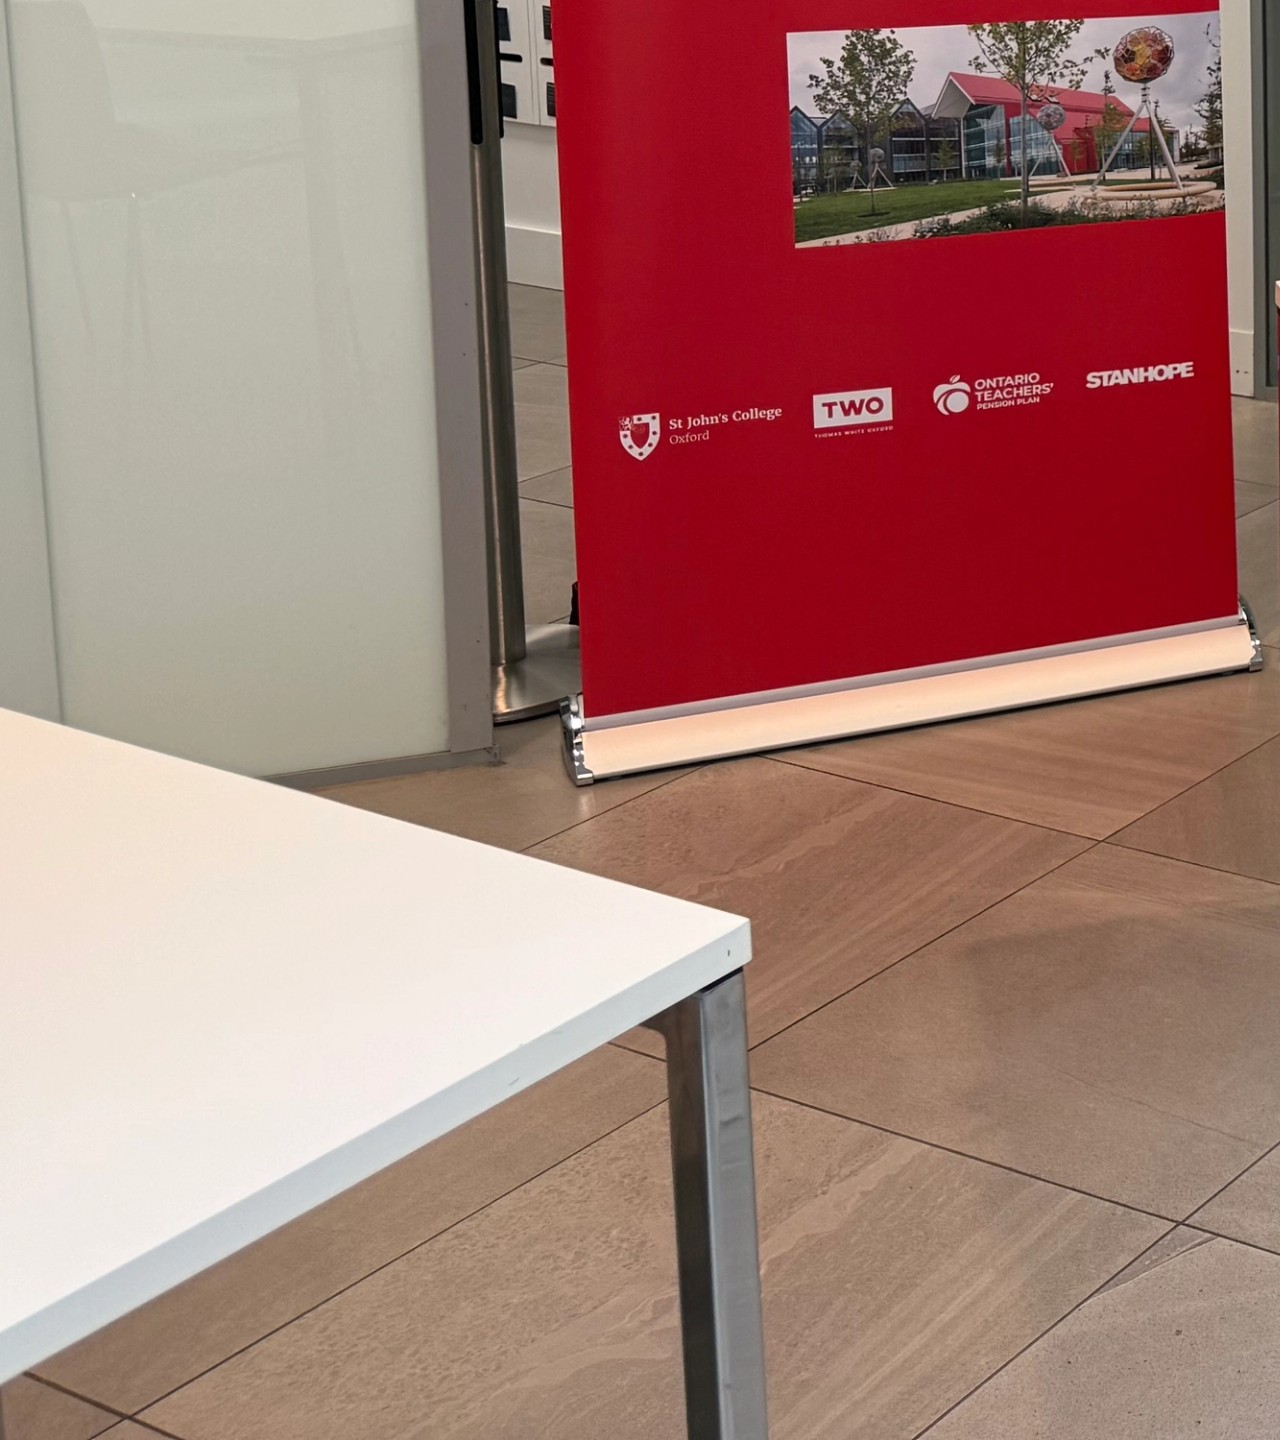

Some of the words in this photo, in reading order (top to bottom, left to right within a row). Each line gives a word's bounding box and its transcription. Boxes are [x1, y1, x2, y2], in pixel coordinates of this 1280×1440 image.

[974, 372, 1040, 391] ONTARIO
[1085, 361, 1195, 389] STANHOPE
[822, 396, 885, 419] TWO
[976, 400, 1015, 411] PENSION
[1016, 397, 1041, 407] PLAN
[669, 418, 683, 430] St
[686, 413, 729, 430] John's
[732, 406, 783, 423] College
[669, 430, 711, 446] Oxford
